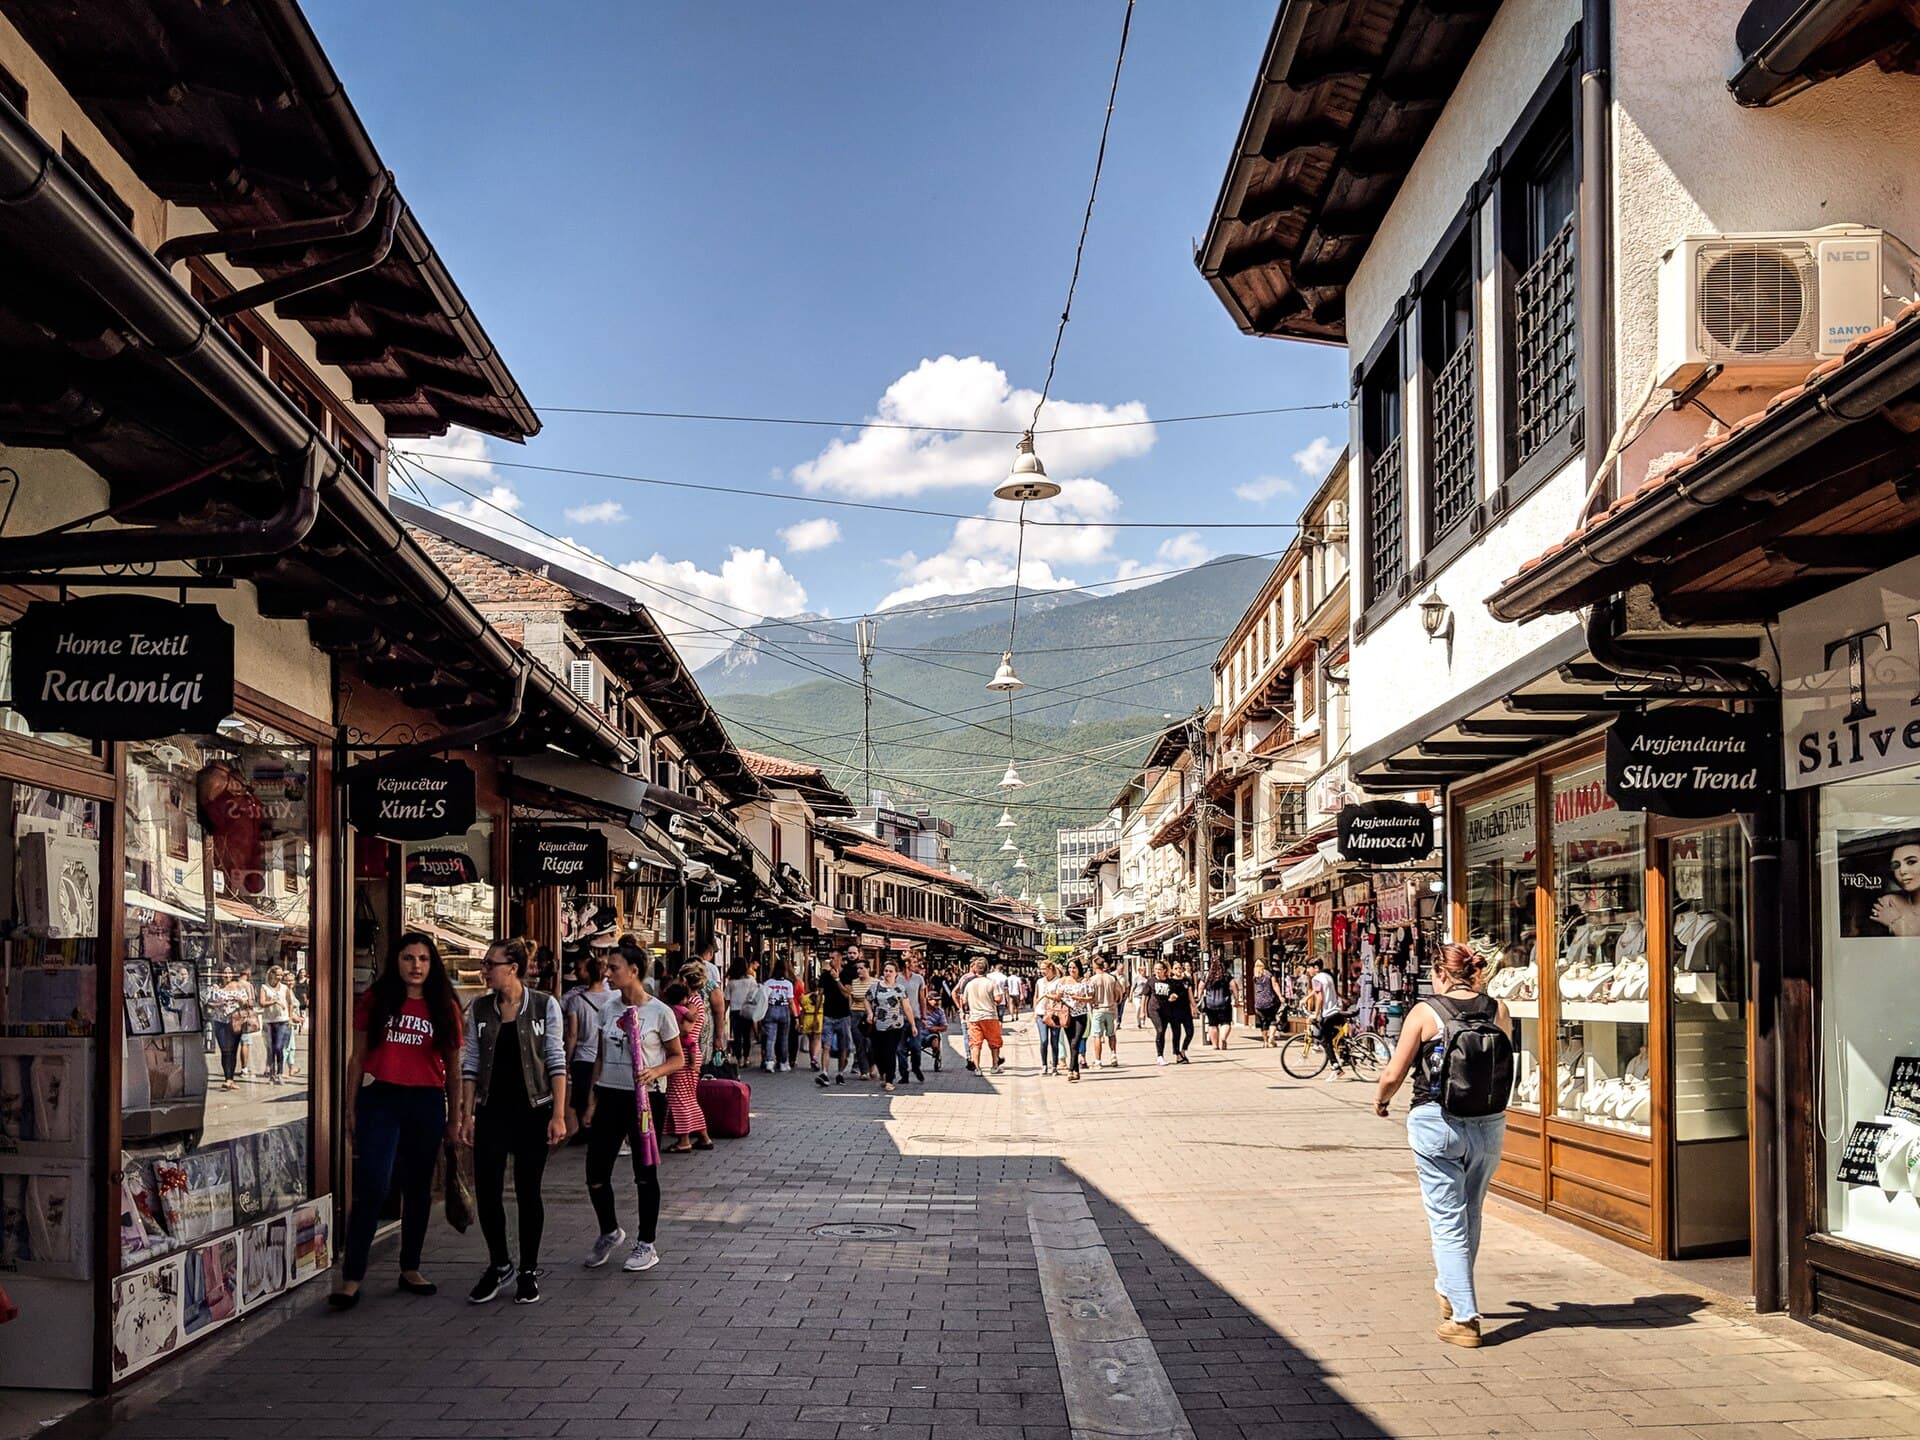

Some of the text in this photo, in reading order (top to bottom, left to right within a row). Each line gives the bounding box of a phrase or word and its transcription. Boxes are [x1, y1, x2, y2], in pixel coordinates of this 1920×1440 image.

[1826, 250, 1870, 262] NEO
[1828, 325, 1871, 336] SANYO
[56, 633, 190, 656] Home Textil
[41, 670, 204, 710] Radoniqi
[1630, 734, 1746, 756] Argjendaria
[376, 777, 449, 794] Këpucëtar
[1619, 764, 1758, 790] Silver Trend
[378, 798, 448, 819] Ximi-S
[1351, 815, 1420, 829] Argjendaria
[538, 841, 589, 852] Këpucëtar
[1347, 832, 1426, 849] Mimoza-N
[541, 856, 585, 875] Rigga
[1841, 873, 1882, 888] TREND
[1268, 905, 1310, 917] ARI
[386, 1029, 424, 1046] ALWAYS
